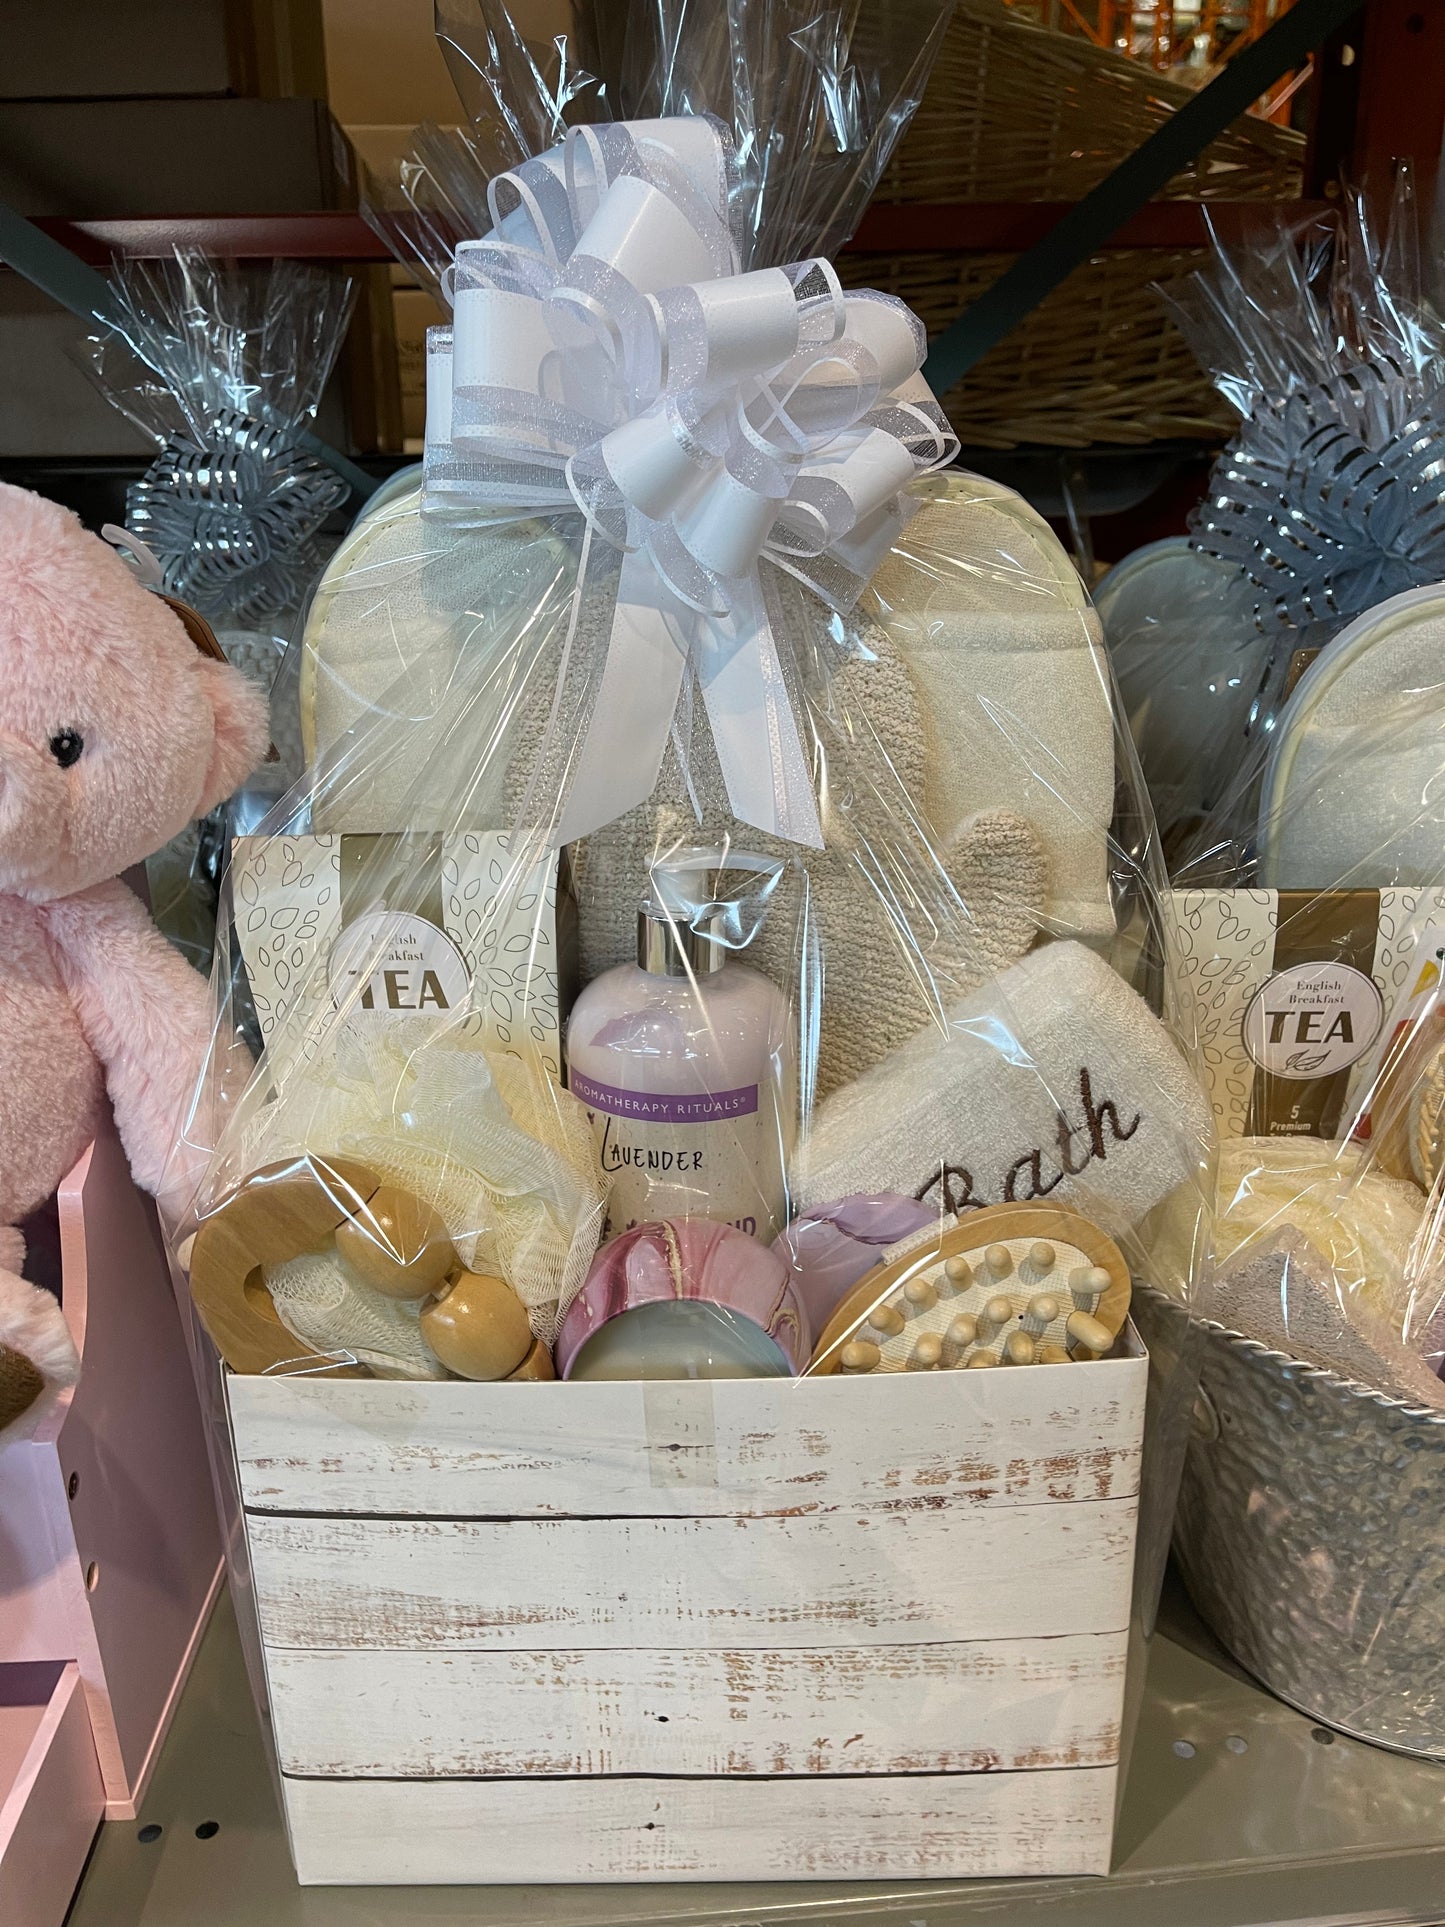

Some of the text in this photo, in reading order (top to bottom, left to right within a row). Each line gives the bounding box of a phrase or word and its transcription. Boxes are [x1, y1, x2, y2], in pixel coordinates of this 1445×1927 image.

[368, 950, 425, 961] akfast
[1296, 980, 1342, 993] English
[1289, 994, 1345, 1004] Breakfast
[1265, 1011, 1354, 1044] TEA
[574, 1079, 669, 1114] AROMATHERAPY
[1290, 1105, 1301, 1119] 5
[1270, 1121, 1312, 1131] Premium
[914, 1066, 1141, 1216] Bath
